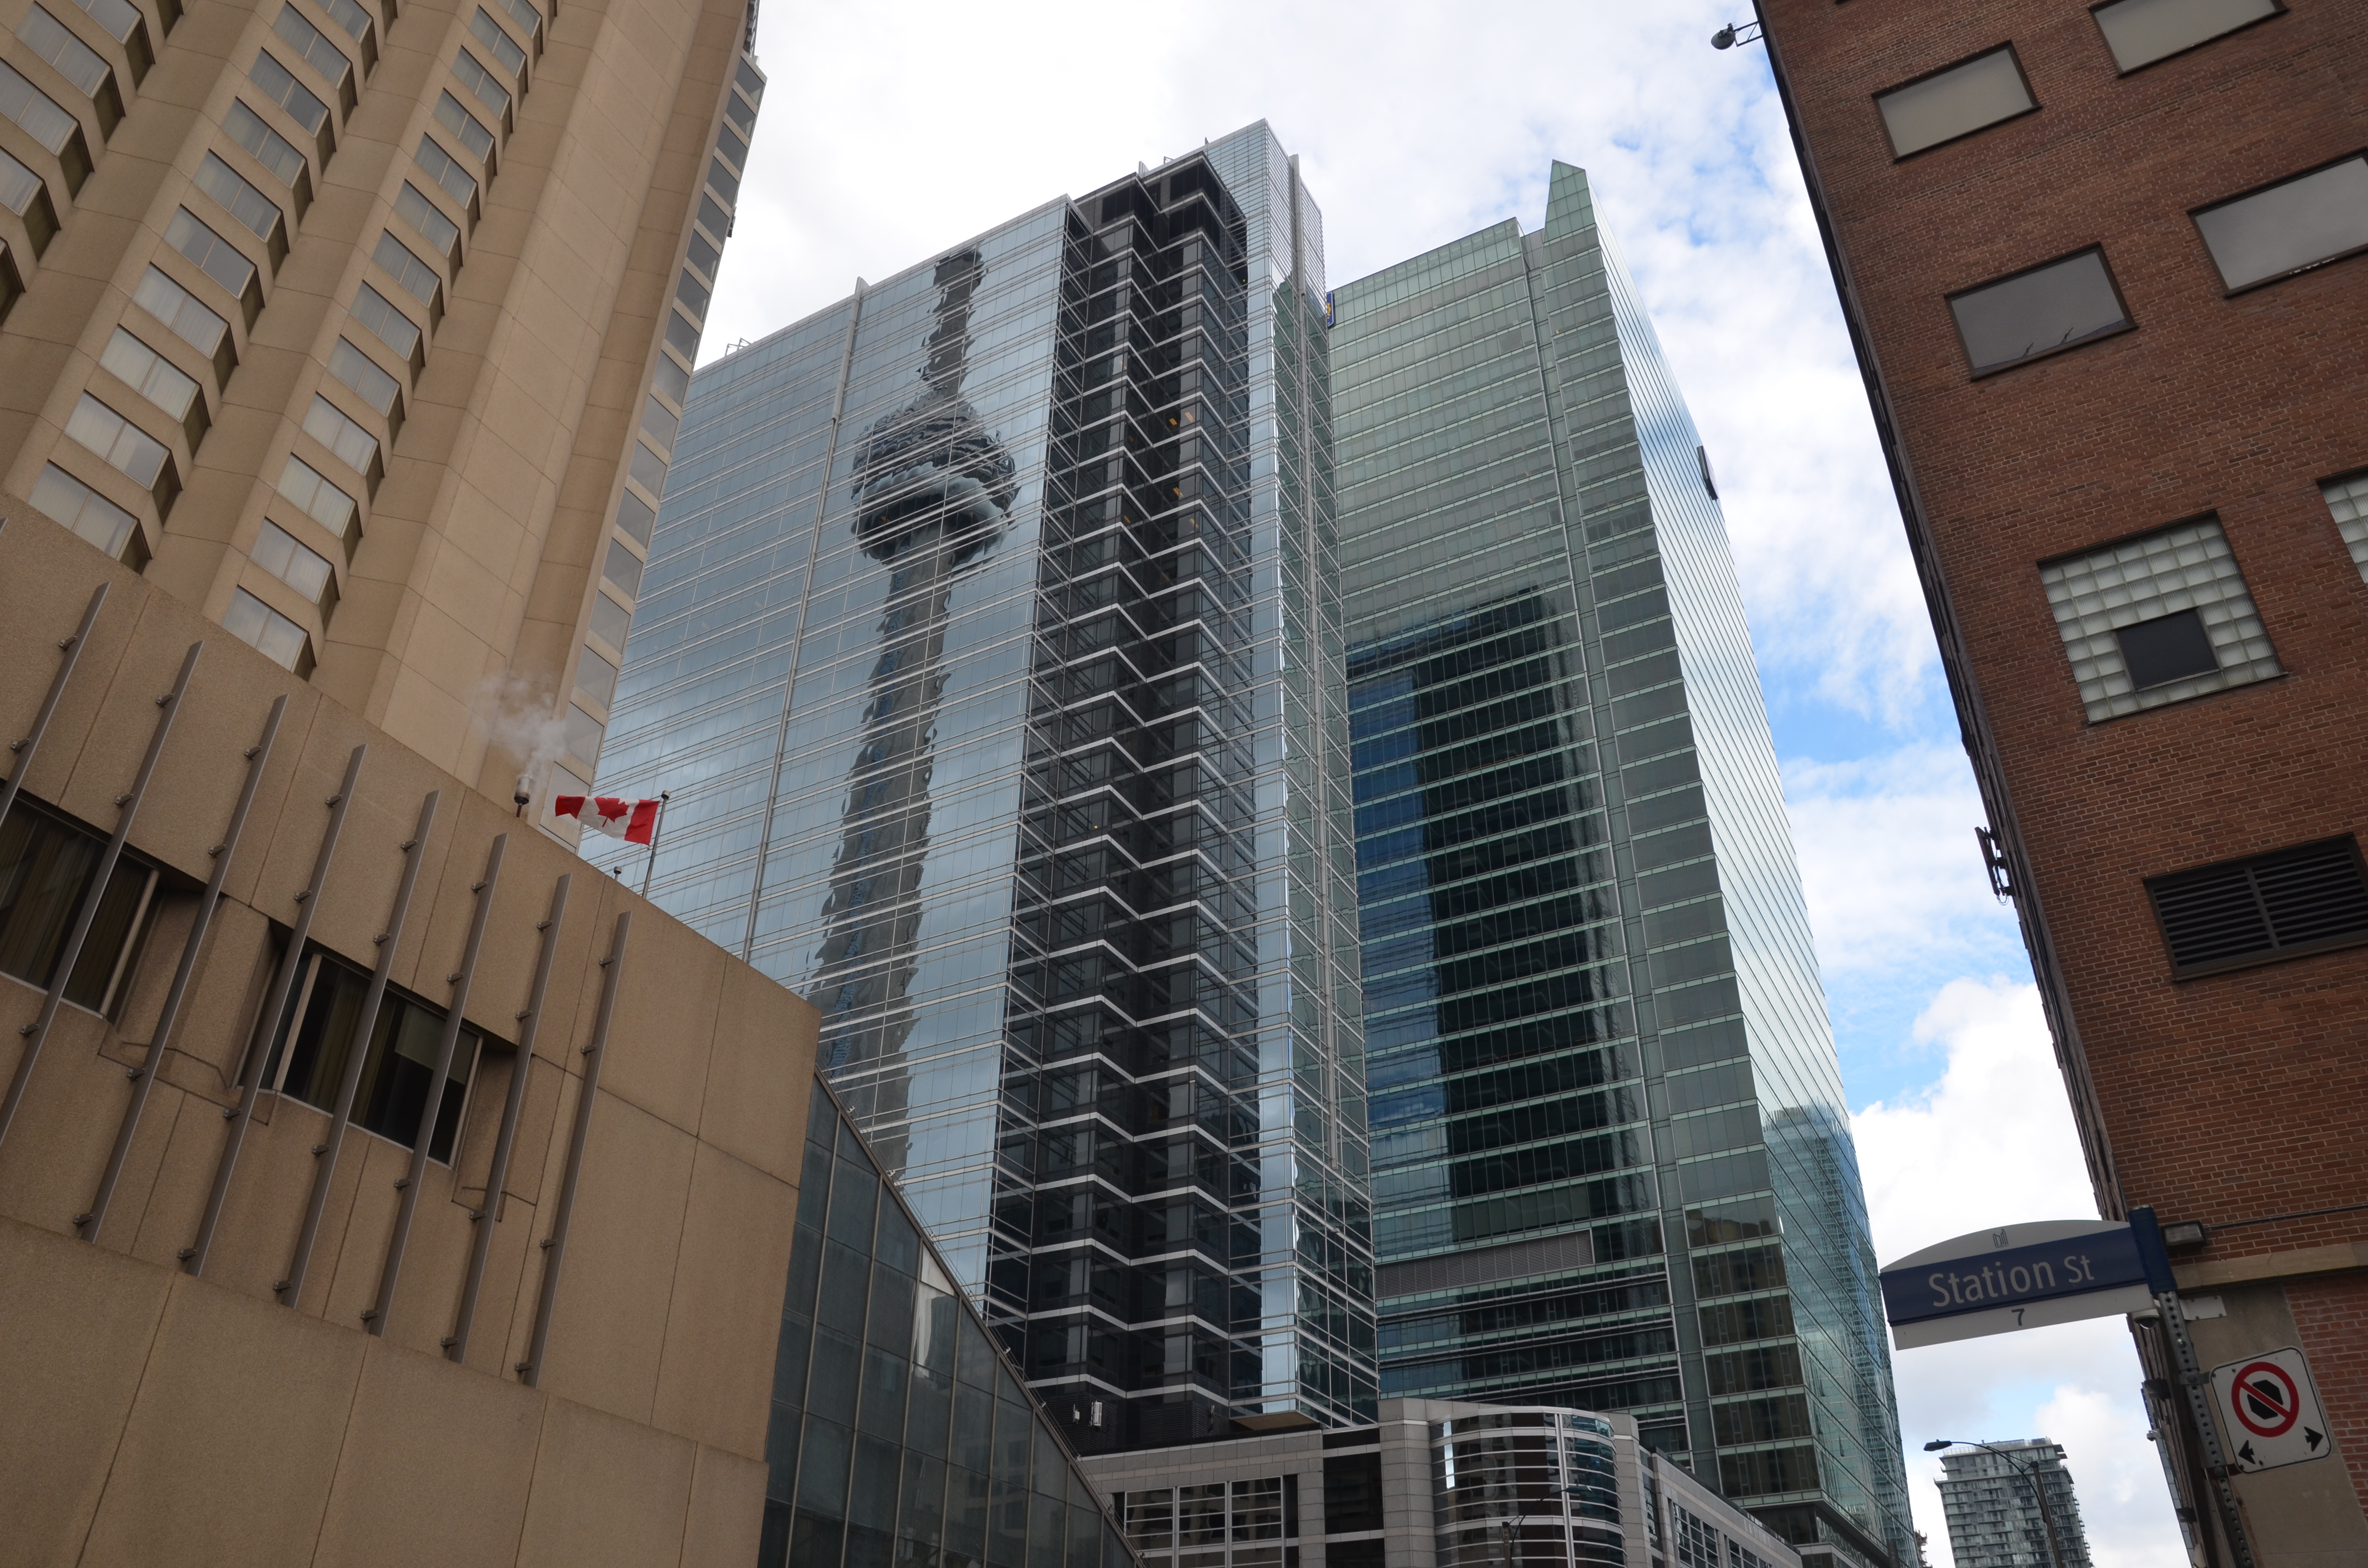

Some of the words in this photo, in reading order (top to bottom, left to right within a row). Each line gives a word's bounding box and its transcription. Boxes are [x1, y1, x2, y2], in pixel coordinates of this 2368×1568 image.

[1929, 1262, 2055, 1307] Station
[2064, 1255, 2095, 1283] St
[2011, 1308, 2025, 1326] 7
